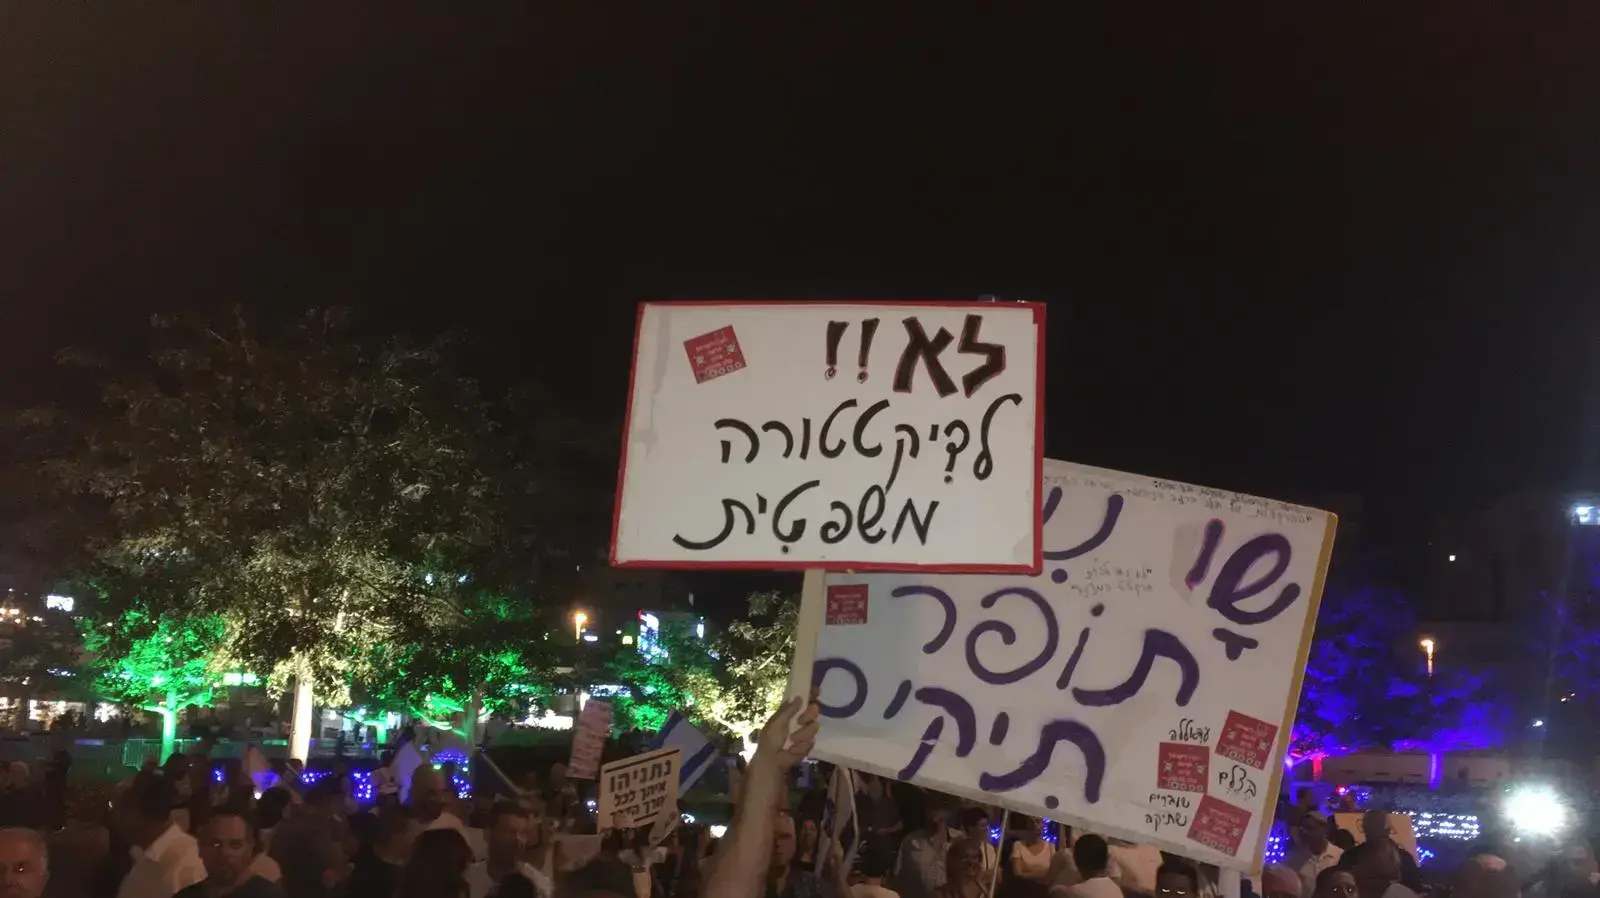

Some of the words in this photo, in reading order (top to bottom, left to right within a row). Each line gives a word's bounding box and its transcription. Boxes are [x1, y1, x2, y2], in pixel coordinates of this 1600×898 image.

[713, 393, 1023, 494] לדיקטטורה
[672, 479, 940, 553] משפטית
[891, 585, 1200, 707] תופר
[813, 657, 1106, 808] תיקים
[608, 759, 673, 793] נתניהו
[613, 789, 637, 807] לכל
[1143, 811, 1188, 833] שתיקה
